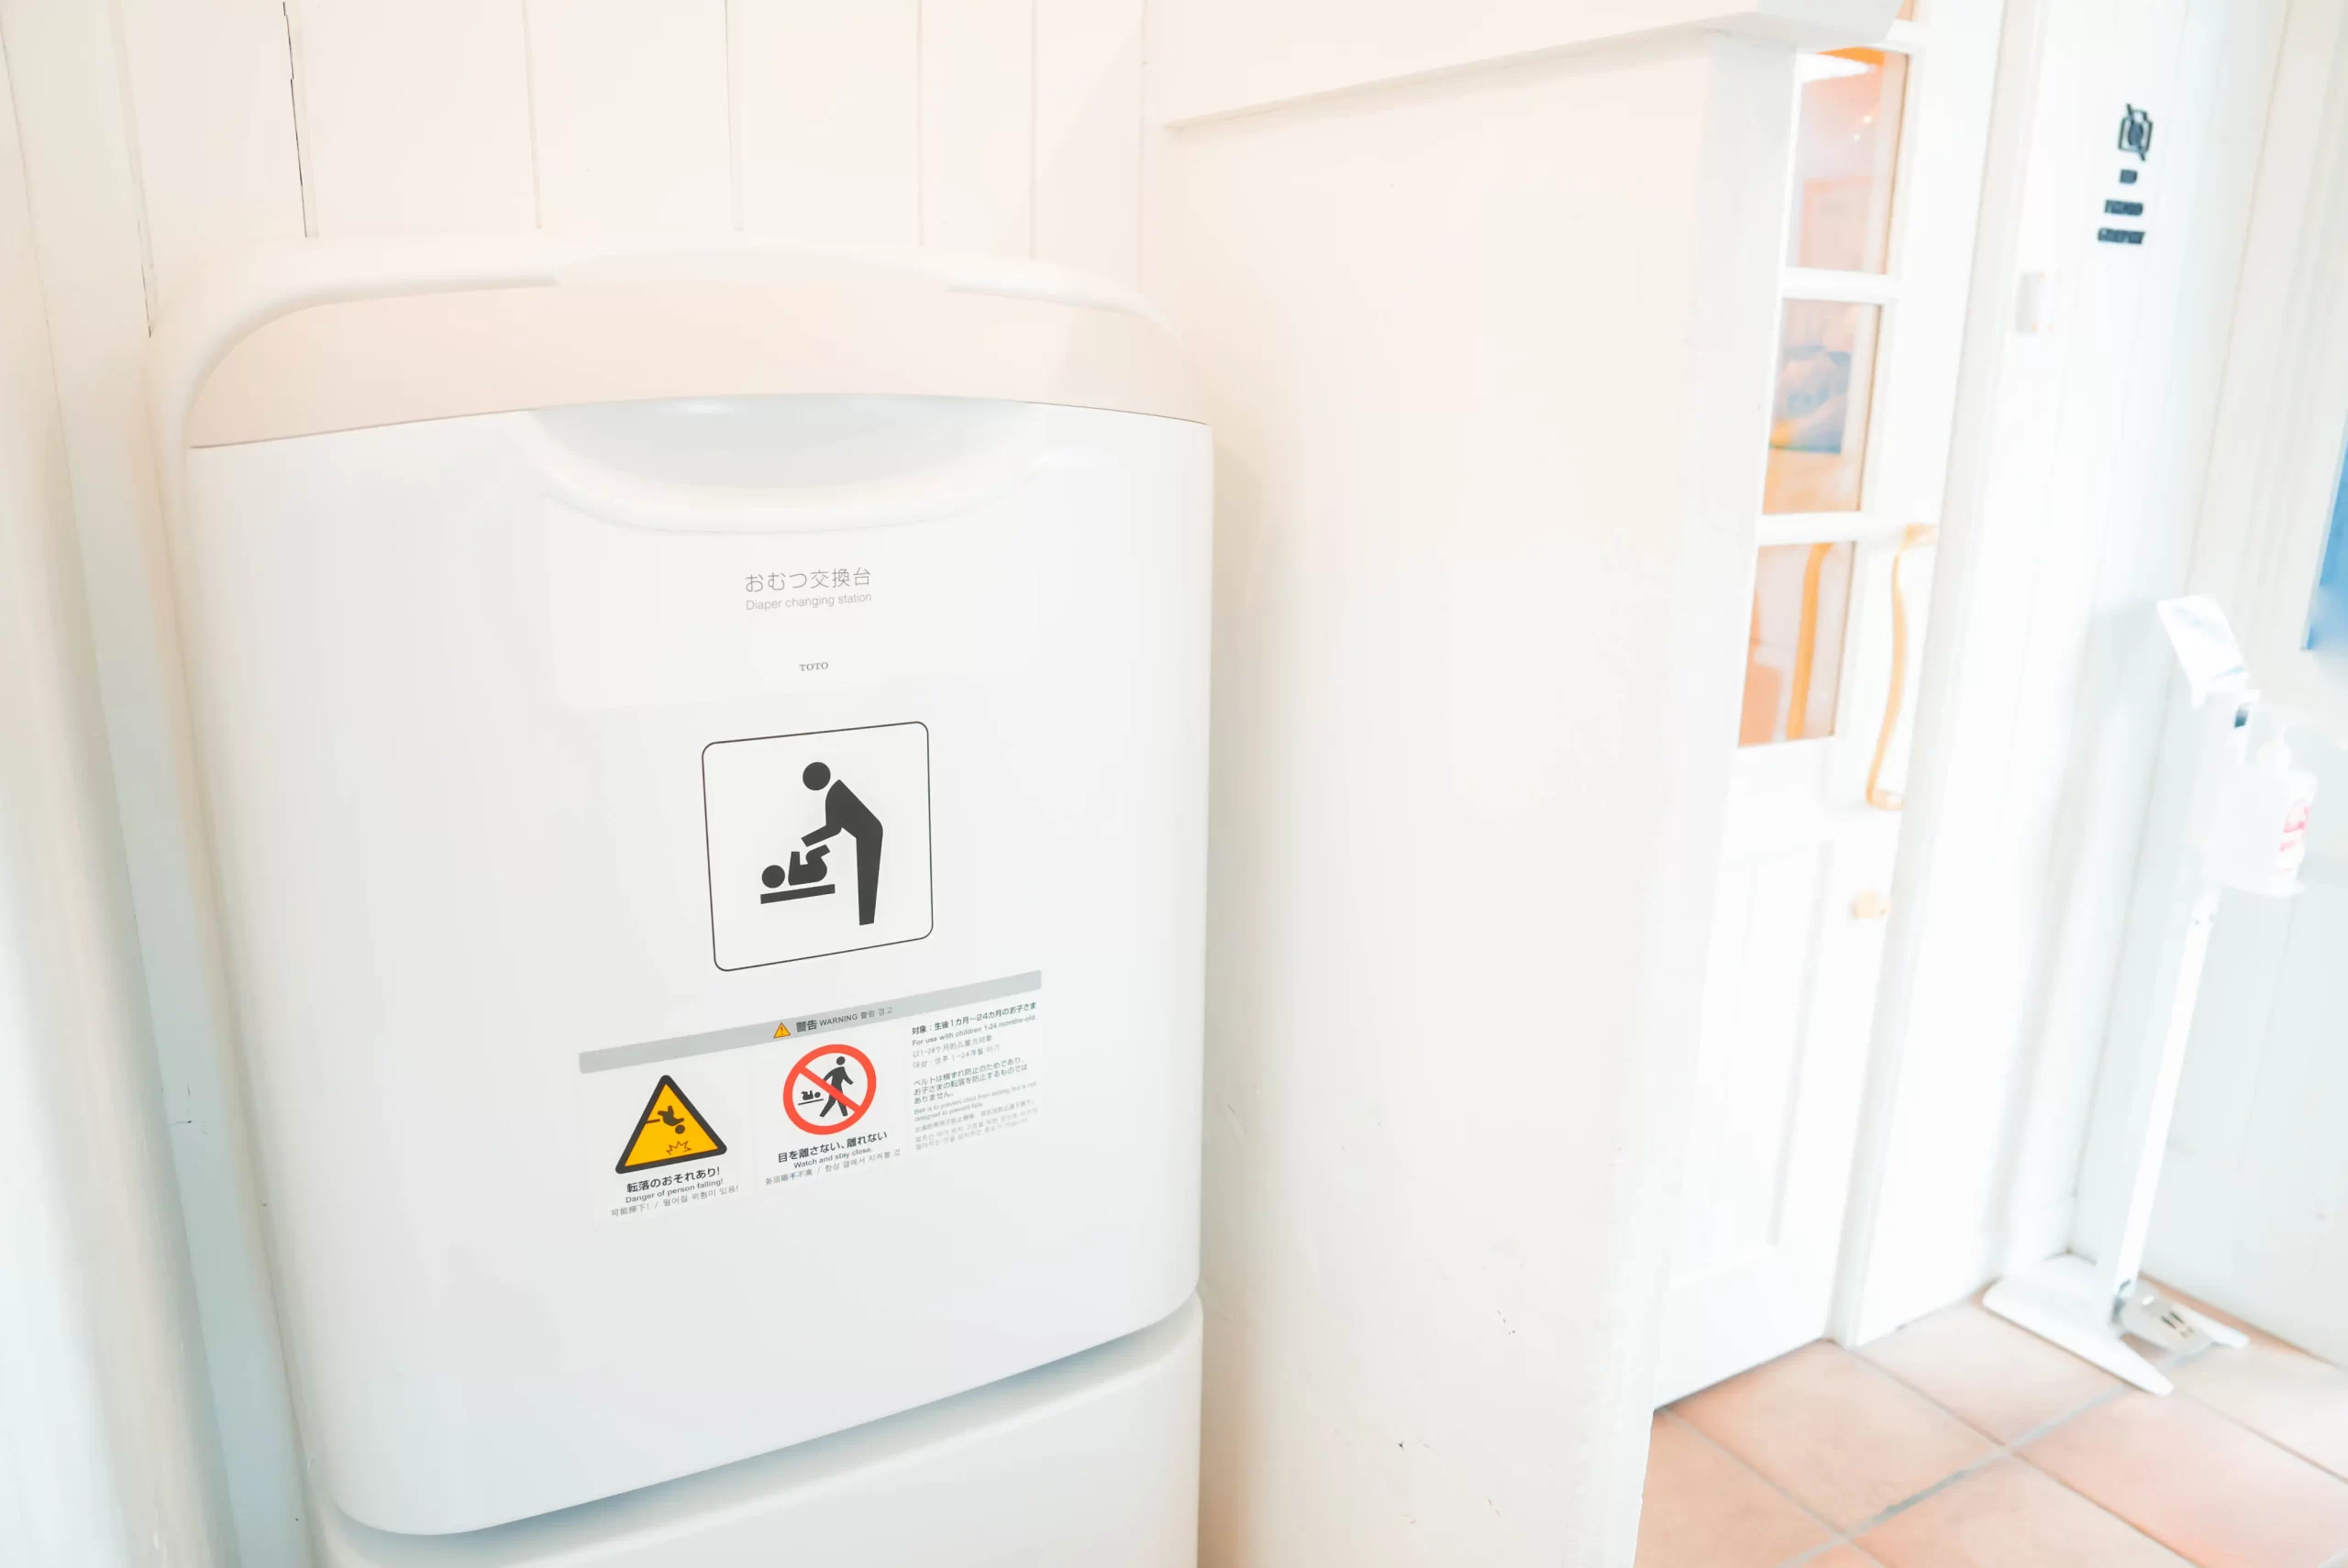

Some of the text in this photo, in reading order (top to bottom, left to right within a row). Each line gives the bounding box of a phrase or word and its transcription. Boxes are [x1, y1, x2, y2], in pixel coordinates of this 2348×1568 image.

[745, 567, 871, 592] おむつ交換台
[746, 592, 872, 612] Diaper changing station
[799, 661, 829, 671] TOTO
[819, 1013, 858, 1027] WARNING
[912, 1038, 924, 1047] For
[925, 1036, 937, 1044] use
[939, 1032, 954, 1042] with
[956, 1026, 982, 1038] children
[984, 1023, 997, 1032] 1-24
[793, 1156, 817, 1168] Watch
[819, 1154, 833, 1164] and
[835, 1152, 849, 1162] stay
[626, 1177, 724, 1204] Danger of person falling!
